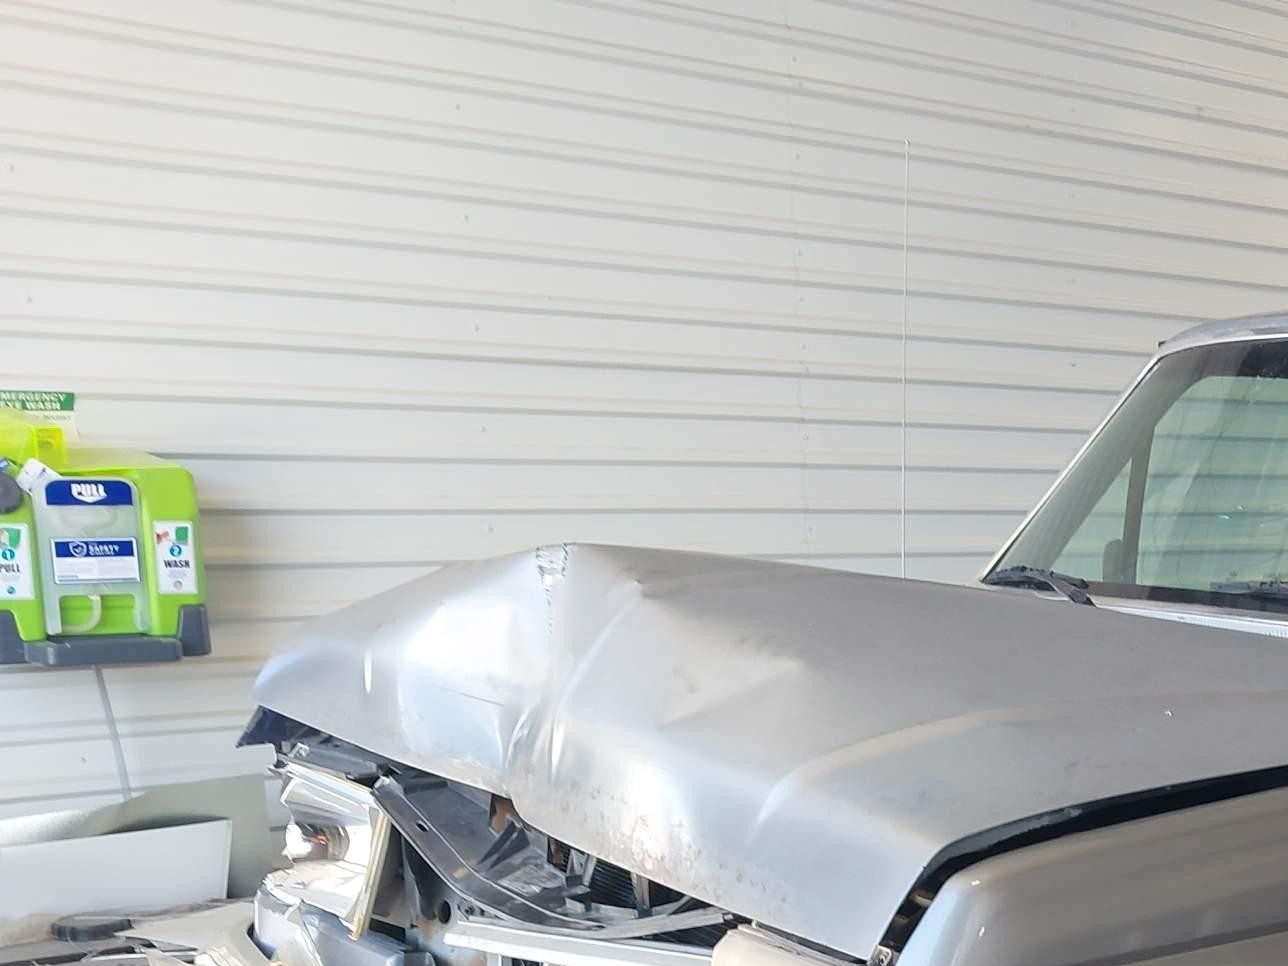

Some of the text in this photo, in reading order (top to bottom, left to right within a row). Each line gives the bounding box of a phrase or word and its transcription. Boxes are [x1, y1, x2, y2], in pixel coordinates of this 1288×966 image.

[0, 392, 66, 401] MERGENCY
[70, 483, 107, 497] PULL
[163, 559, 190, 568] WASH
